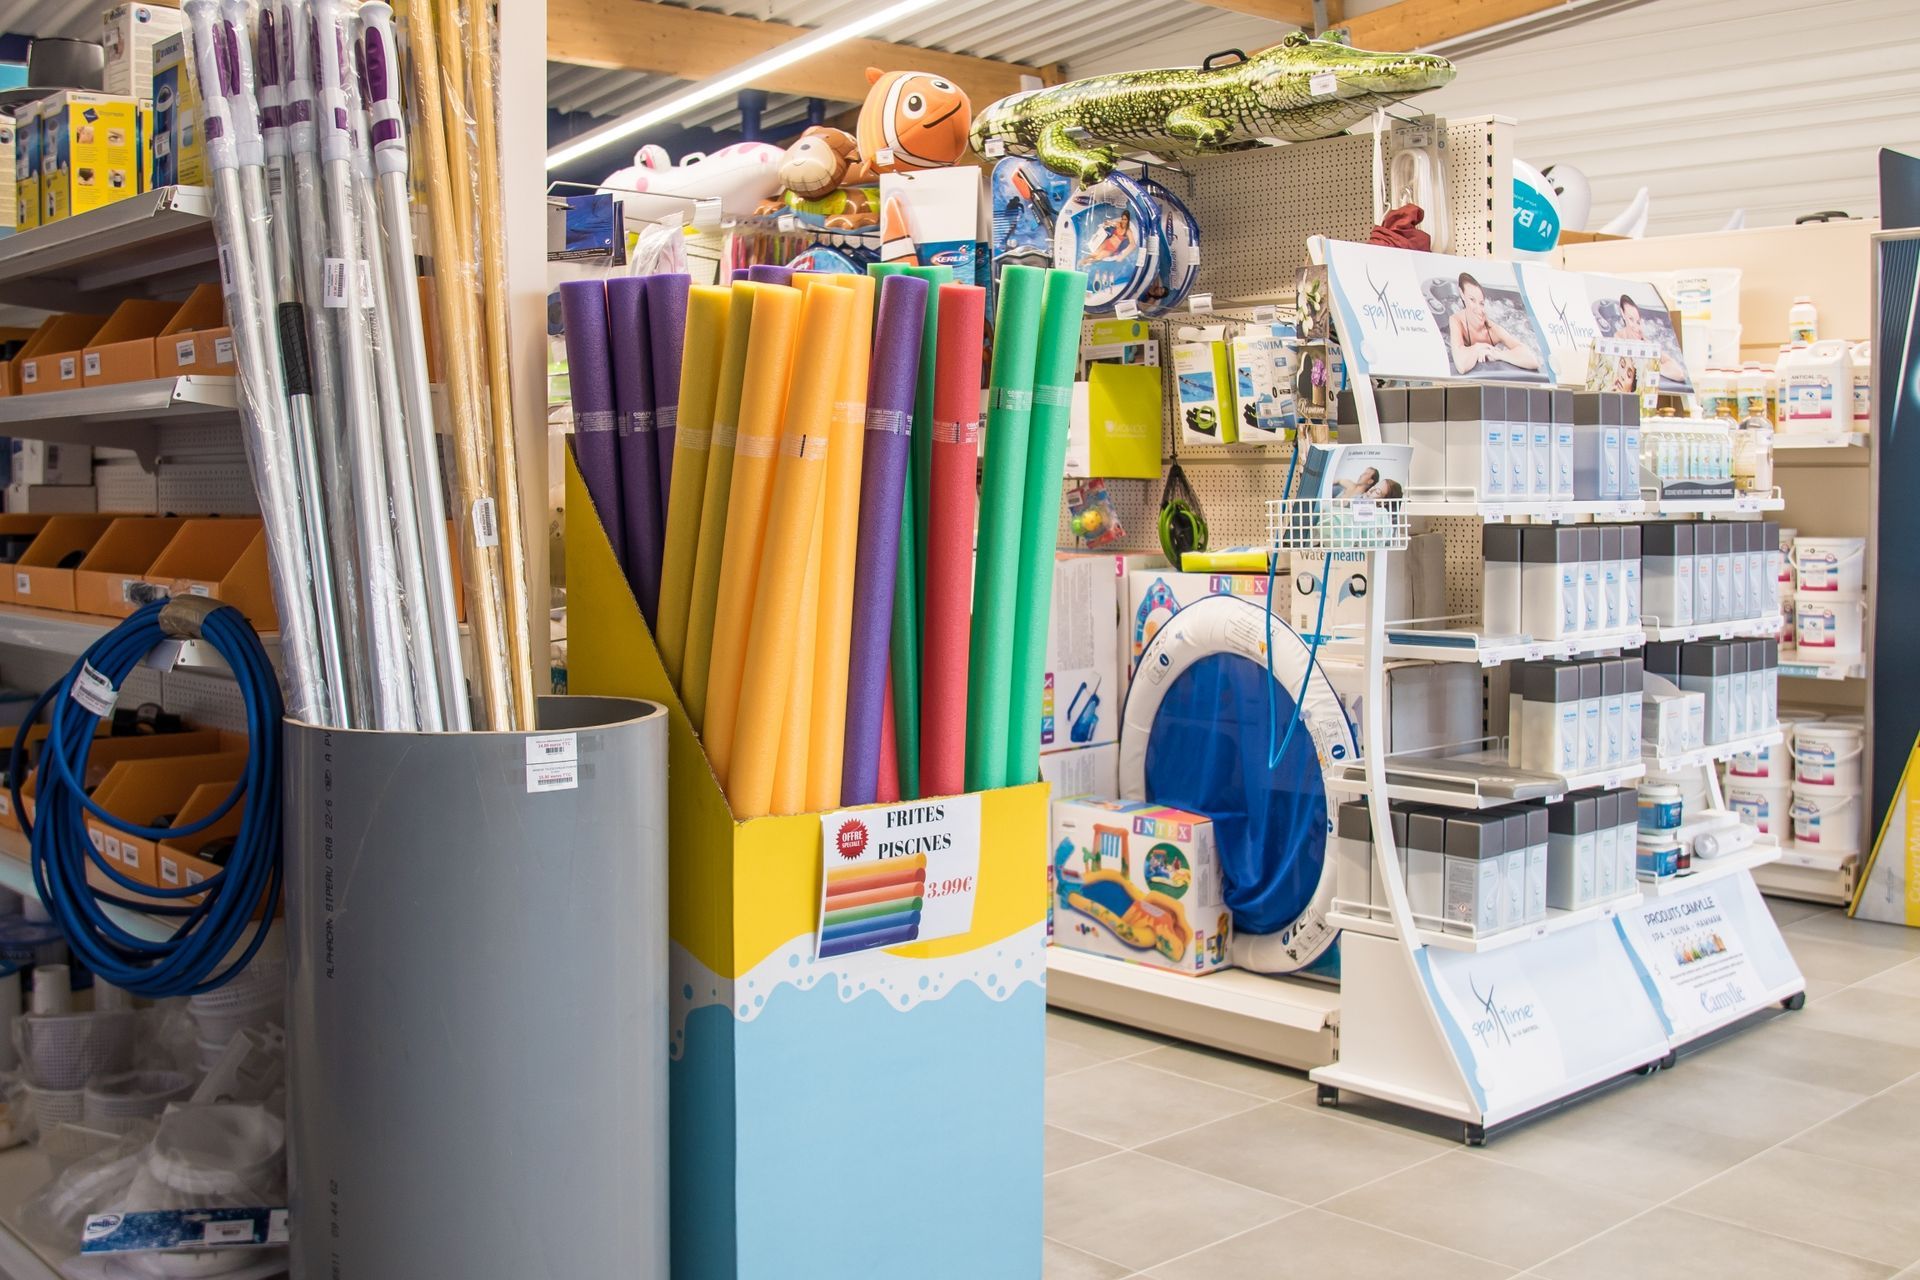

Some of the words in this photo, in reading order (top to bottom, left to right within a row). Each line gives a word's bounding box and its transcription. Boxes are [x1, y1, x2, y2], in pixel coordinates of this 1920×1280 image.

[932, 254, 969, 264] KERLIS
[1363, 304, 1385, 330] spa
[1391, 301, 1424, 321] time
[1257, 340, 1284, 351] SWIM
[1549, 323, 1567, 346] spa
[1571, 320, 1595, 338] time
[1300, 551, 1325, 561] Wate
[1211, 577, 1266, 594] INTEX
[1042, 673, 1054, 742] INTEX
[324, 799, 333, 830] 22/6
[887, 804, 945, 828] FRITES
[842, 830, 863, 842] OFFRE
[1134, 818, 1190, 841] INTEX
[878, 833, 952, 860] PISCINES
[927, 876, 973, 898] 3.99€
[1643, 906, 1682, 926] PRODUITS
[1681, 896, 1716, 916] CAMYLLE
[1652, 931, 1665, 941] SPA
[1670, 924, 1690, 936] SAUNA
[326, 917, 334, 980] ALPHACAN
[1700, 981, 1746, 1014] Camylle
[1472, 1018, 1494, 1048] spa
[1500, 1004, 1533, 1025] time
